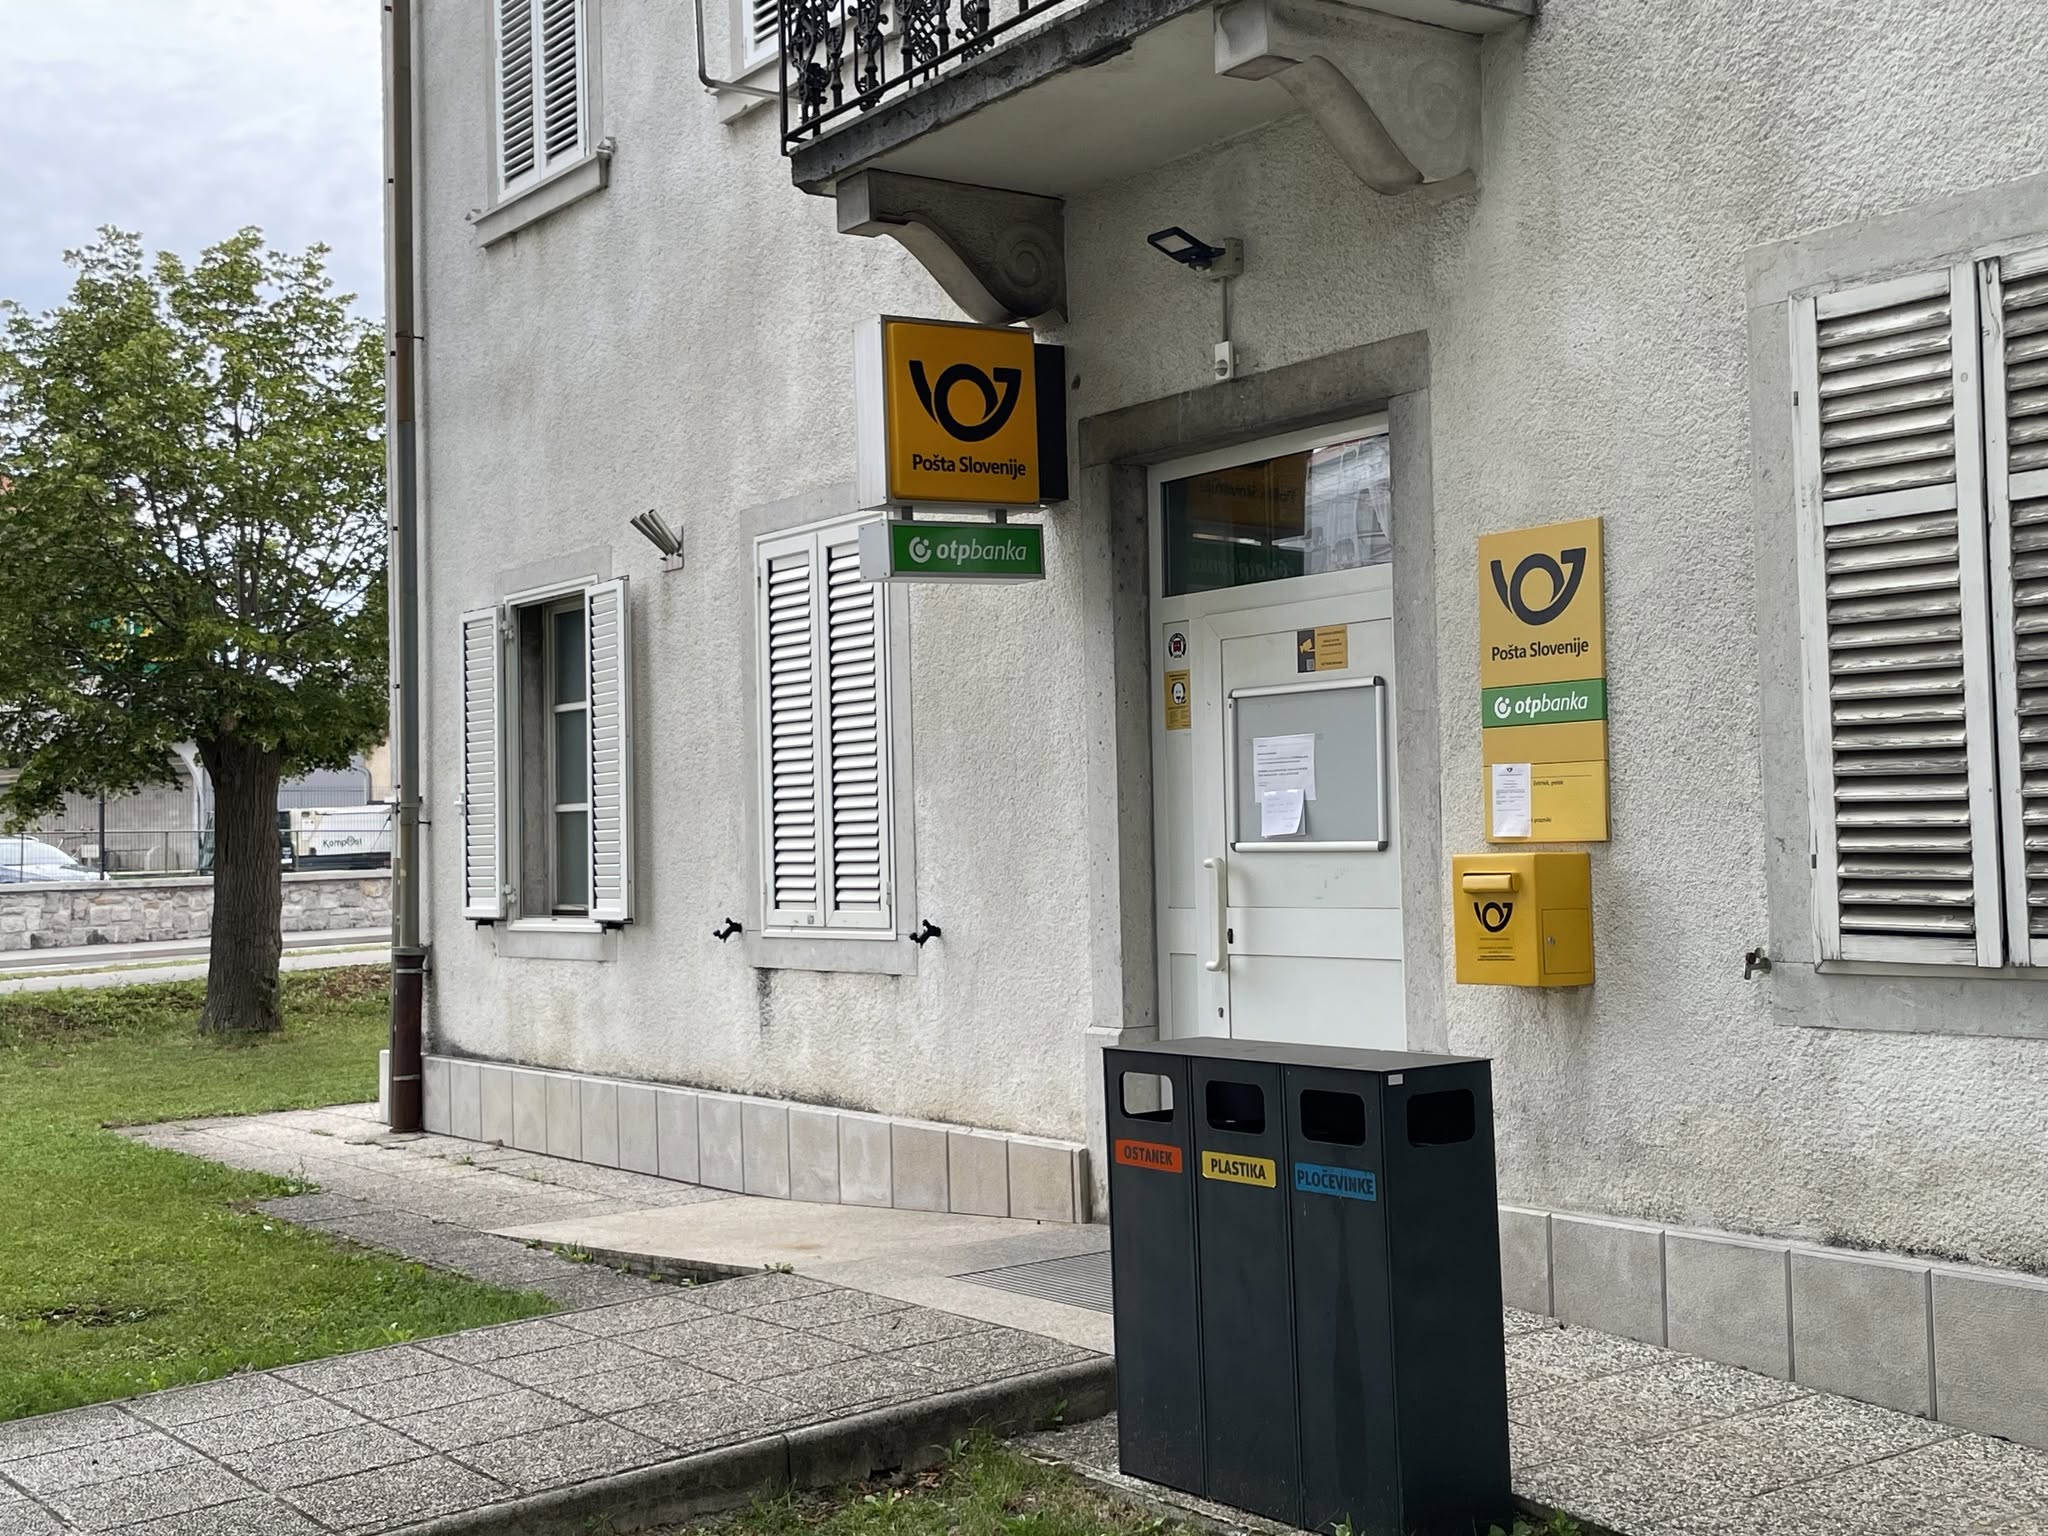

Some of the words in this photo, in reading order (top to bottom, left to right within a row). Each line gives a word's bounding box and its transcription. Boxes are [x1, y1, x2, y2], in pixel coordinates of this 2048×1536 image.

[912, 453, 955, 473] Pošta
[960, 456, 1026, 480] Slovenije
[936, 539, 1027, 565] otpbanka
[1492, 644, 1527, 661] Pošta
[1530, 637, 1589, 658] Slovenije
[1515, 691, 1588, 718] otpbanka
[1124, 1145, 1173, 1166] OSTANEK
[1211, 1157, 1267, 1180] PLASTIKA
[1297, 1168, 1374, 1195] PLOČEVINKE
